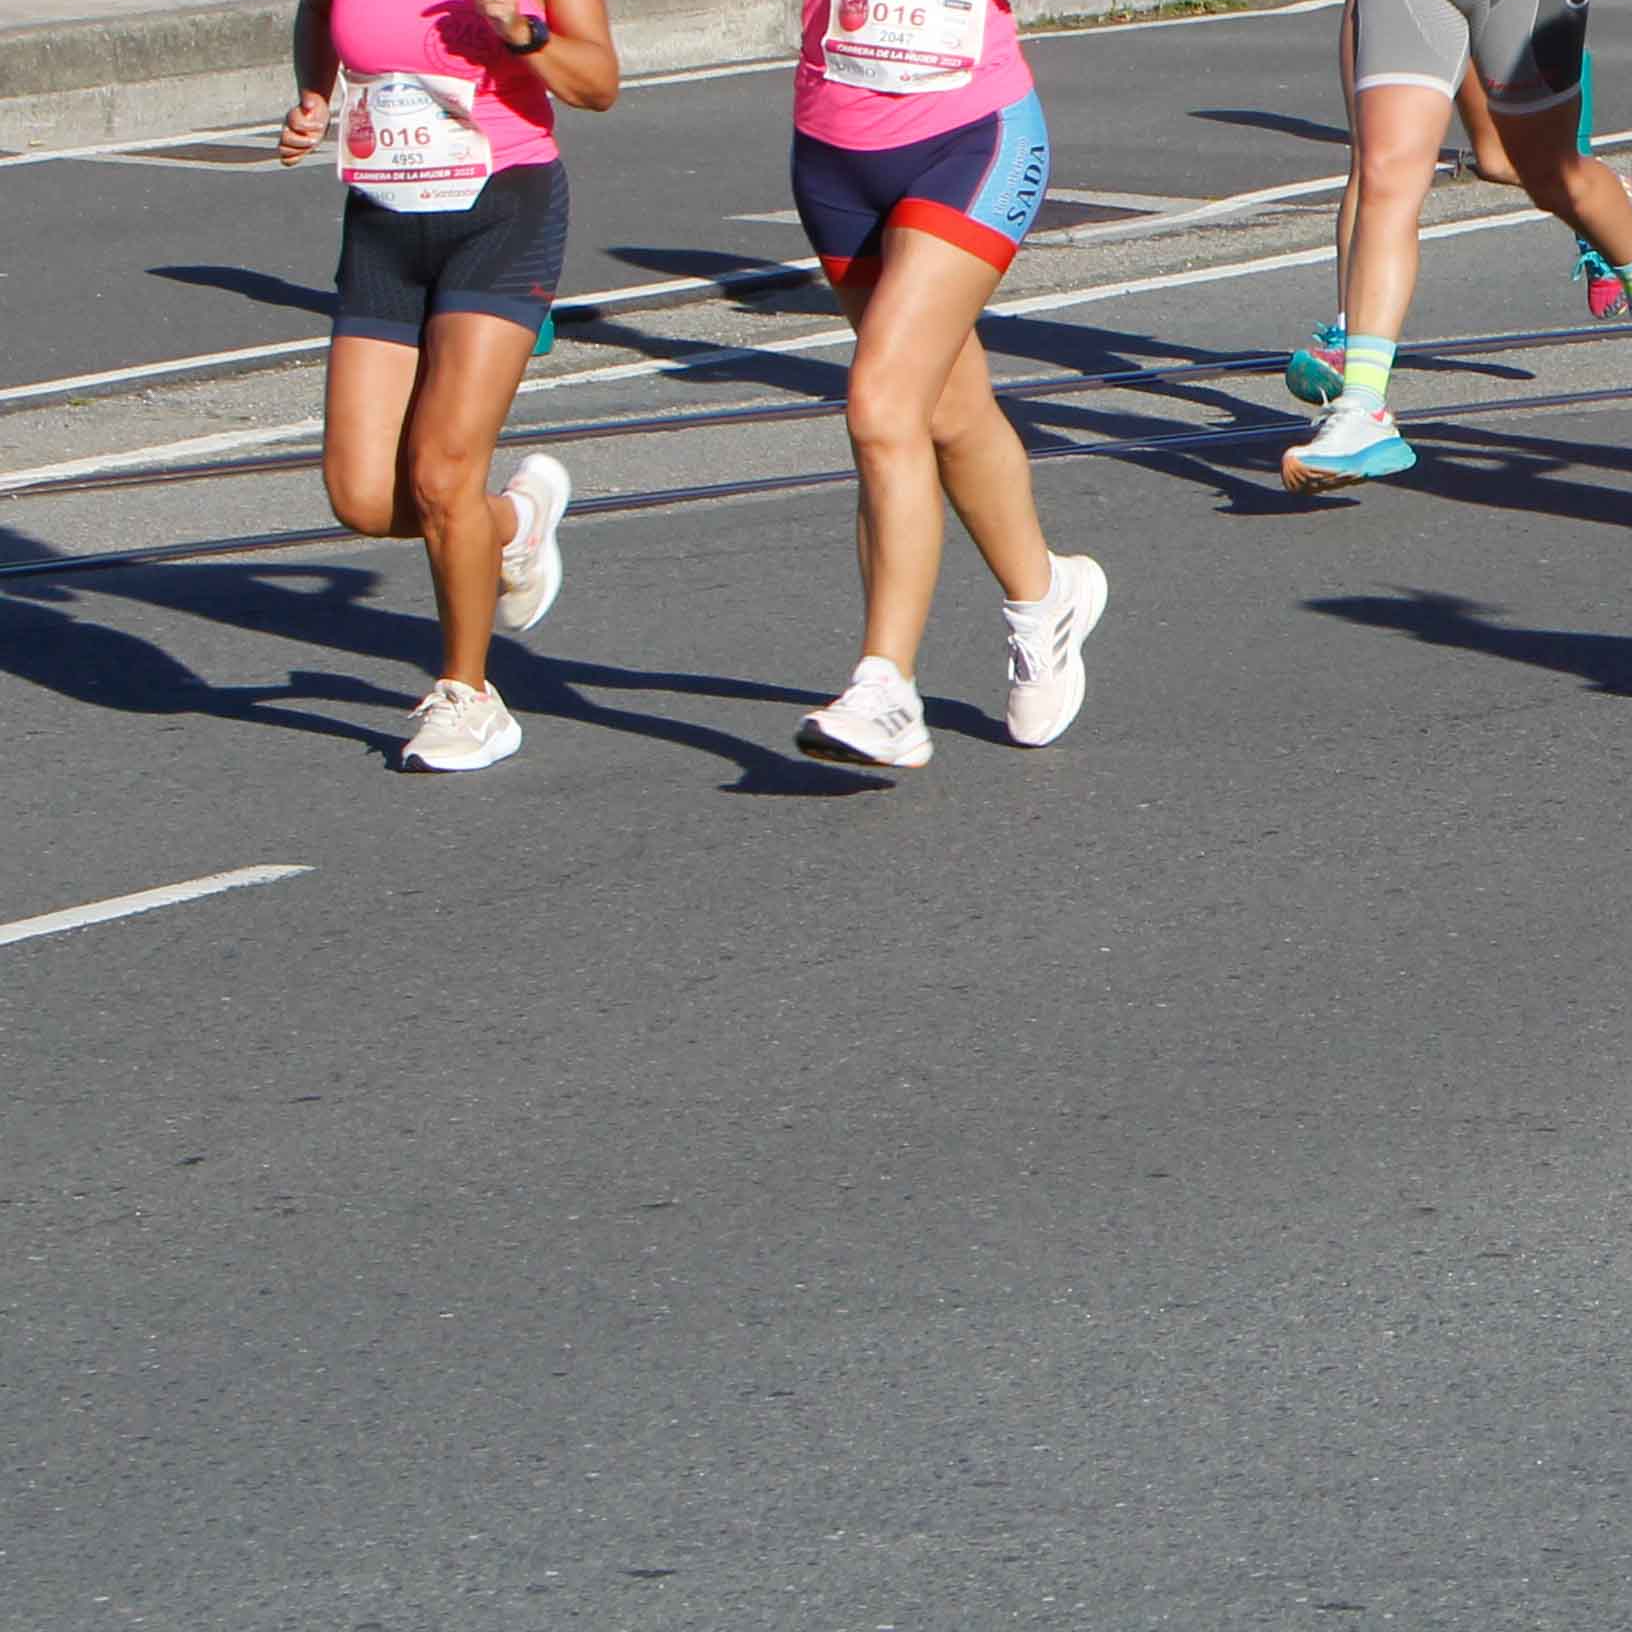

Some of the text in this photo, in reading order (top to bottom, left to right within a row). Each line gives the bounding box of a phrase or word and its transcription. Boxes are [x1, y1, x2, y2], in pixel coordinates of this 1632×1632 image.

[873, 2, 926, 26] 016
[890, 50, 904, 60] LA
[380, 126, 431, 148] 016
[391, 170, 404, 180] DE
[405, 169, 420, 179] LA
[1007, 145, 1045, 227] SADA
